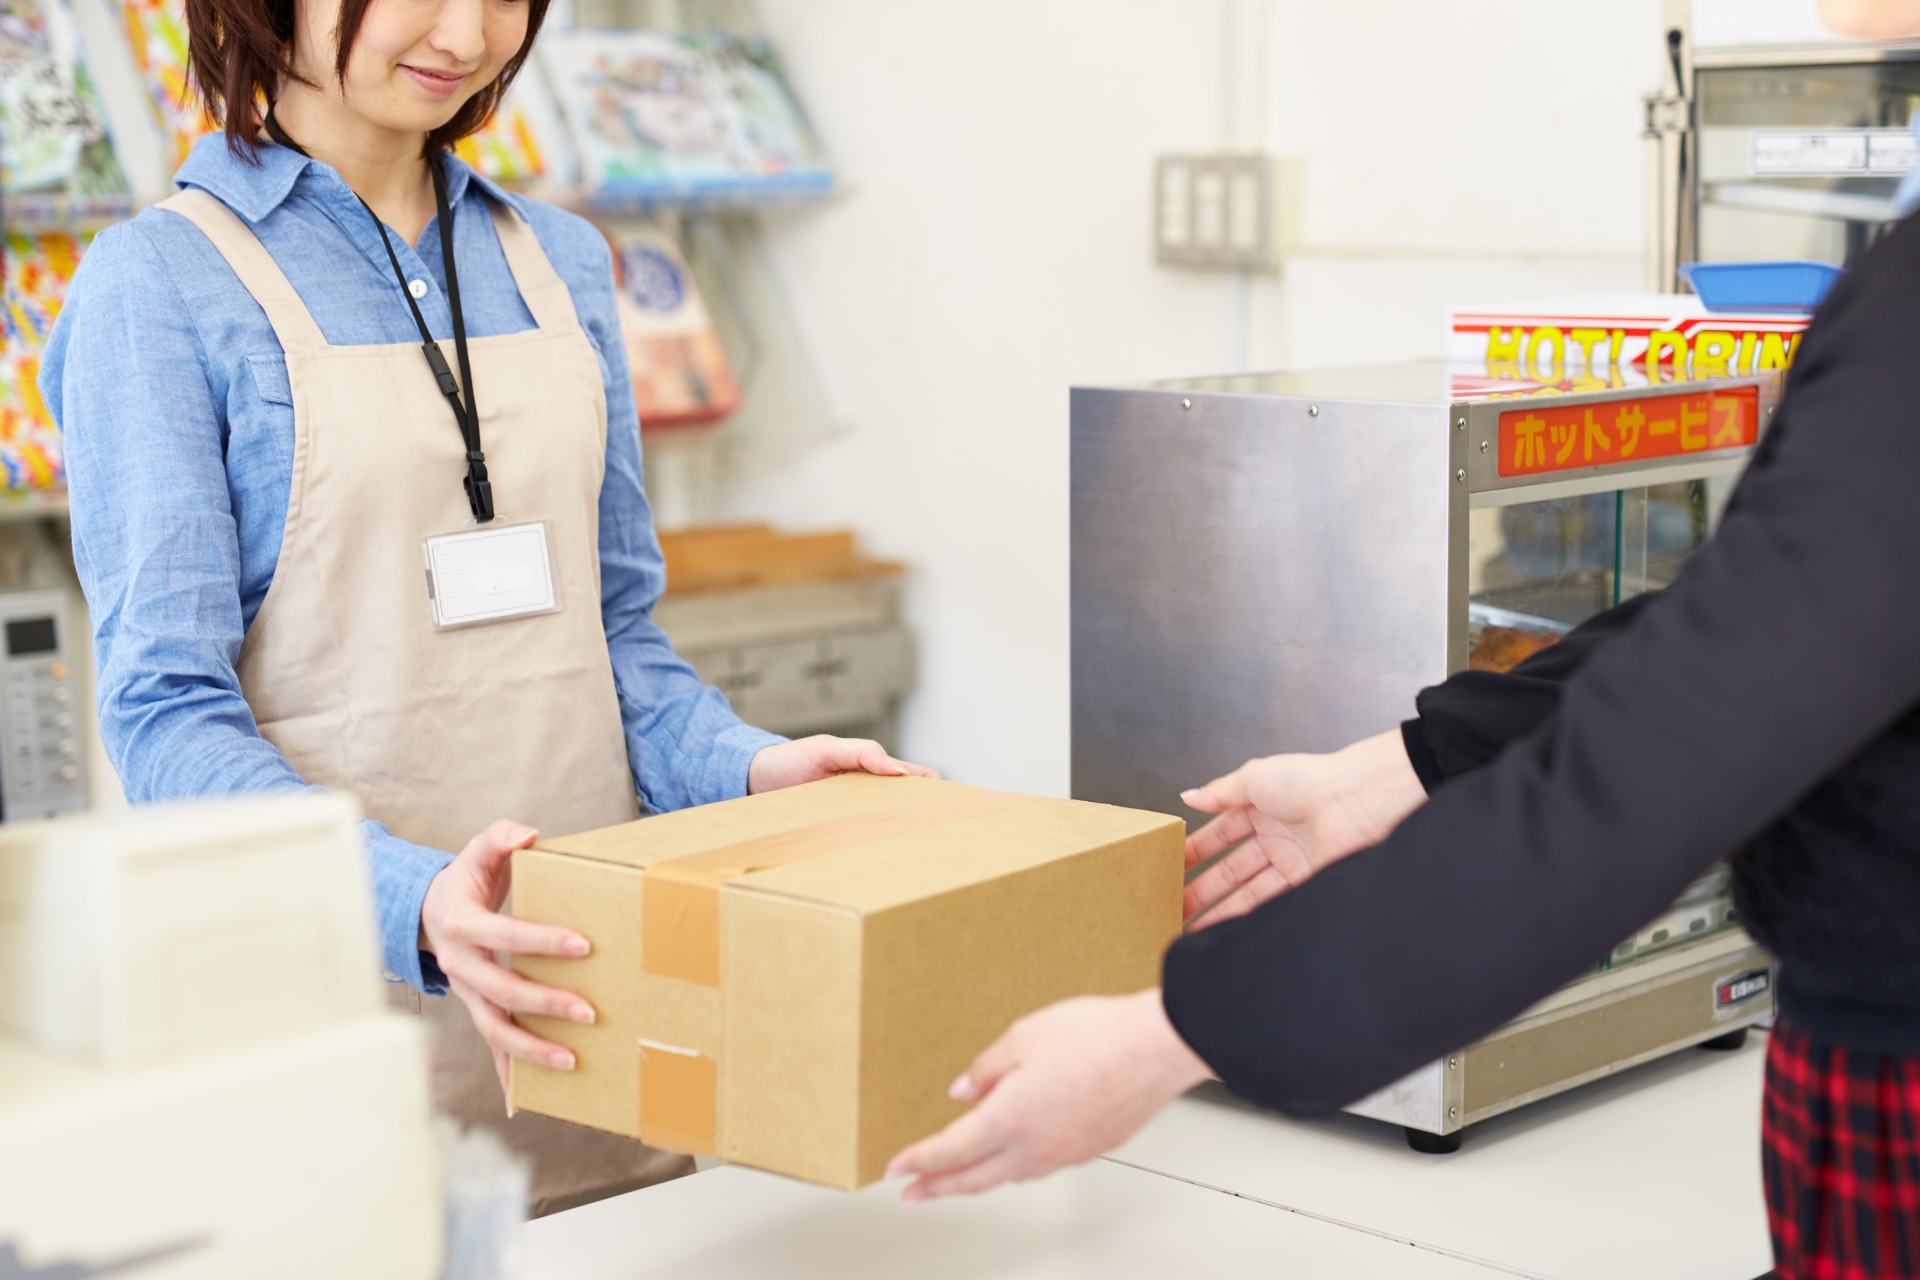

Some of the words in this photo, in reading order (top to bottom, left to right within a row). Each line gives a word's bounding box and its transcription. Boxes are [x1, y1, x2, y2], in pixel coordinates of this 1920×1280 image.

[1486, 325, 1626, 364] HOT!
[1513, 396, 1742, 469] ホットサービス
